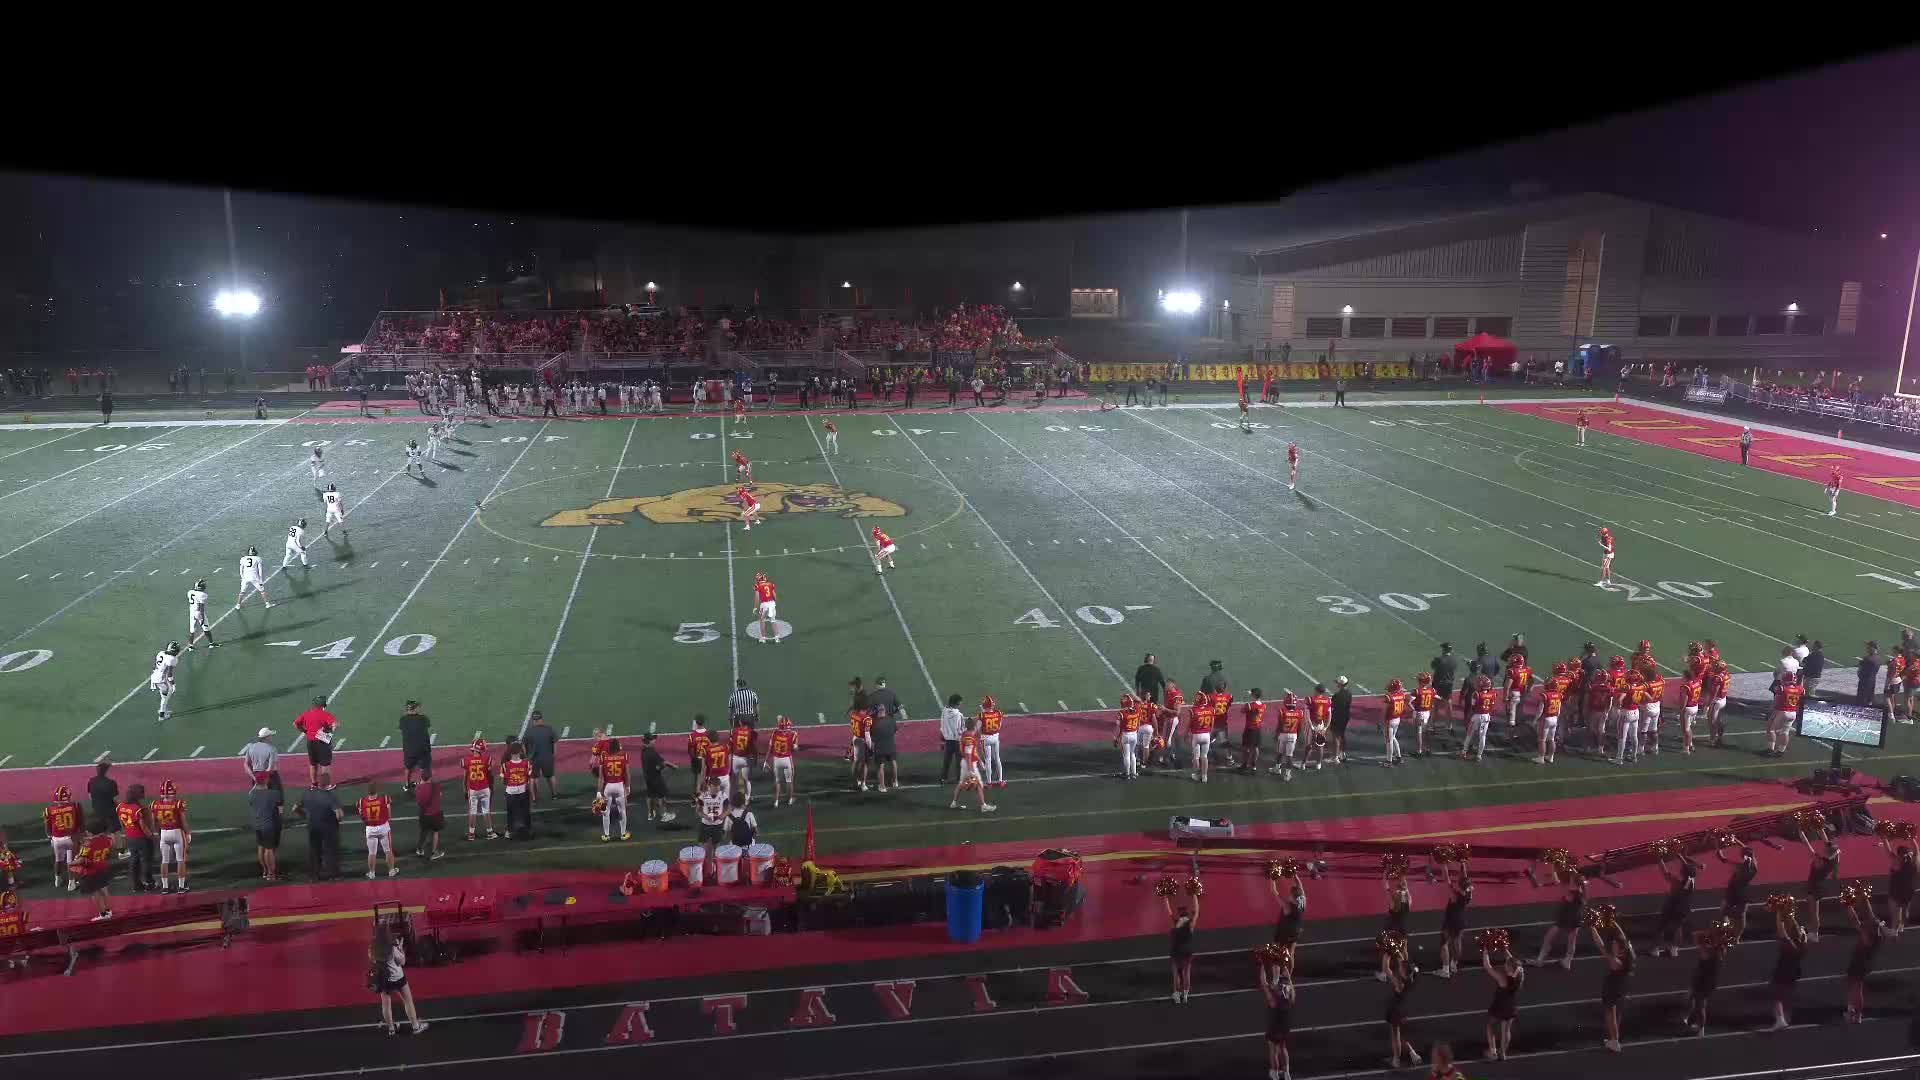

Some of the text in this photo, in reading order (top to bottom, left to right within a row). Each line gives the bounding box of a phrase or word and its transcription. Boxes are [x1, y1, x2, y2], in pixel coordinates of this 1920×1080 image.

[246, 557, 254, 568] 3
[188, 594, 196, 605] 5
[763, 585, 771, 598] 3
[1598, 580, 1714, 602] 20
[1316, 592, 1431, 615] 30
[1013, 604, 1125, 629] 40
[673, 621, 793, 644] 50
[301, 633, 438, 661] 40
[469, 765, 485, 781] 65
[606, 761, 622, 777] 35
[517, 966, 1090, 1055] BATAVIA
